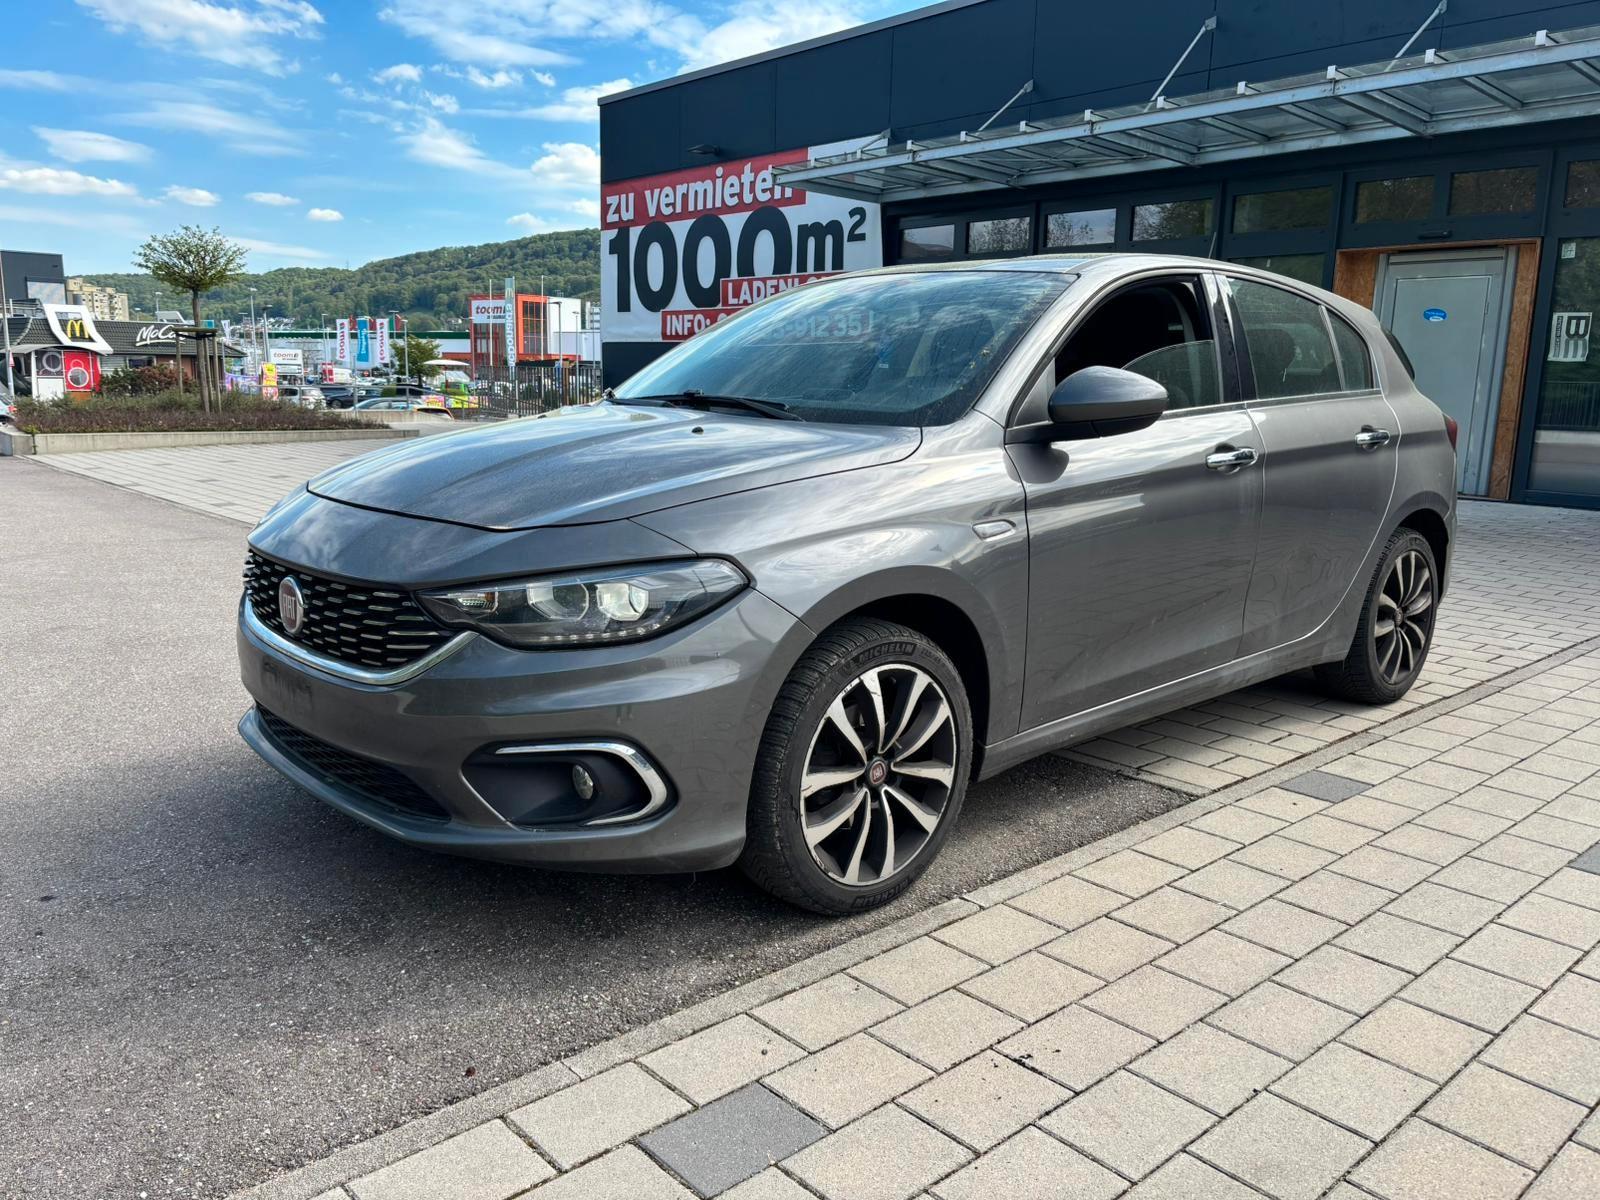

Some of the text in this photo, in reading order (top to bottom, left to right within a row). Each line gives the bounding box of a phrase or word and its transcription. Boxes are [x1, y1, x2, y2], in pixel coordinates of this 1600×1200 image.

[606, 192, 635, 223] zu
[475, 304, 503, 315] toom
[858, 642, 915, 662] MICHELIN
